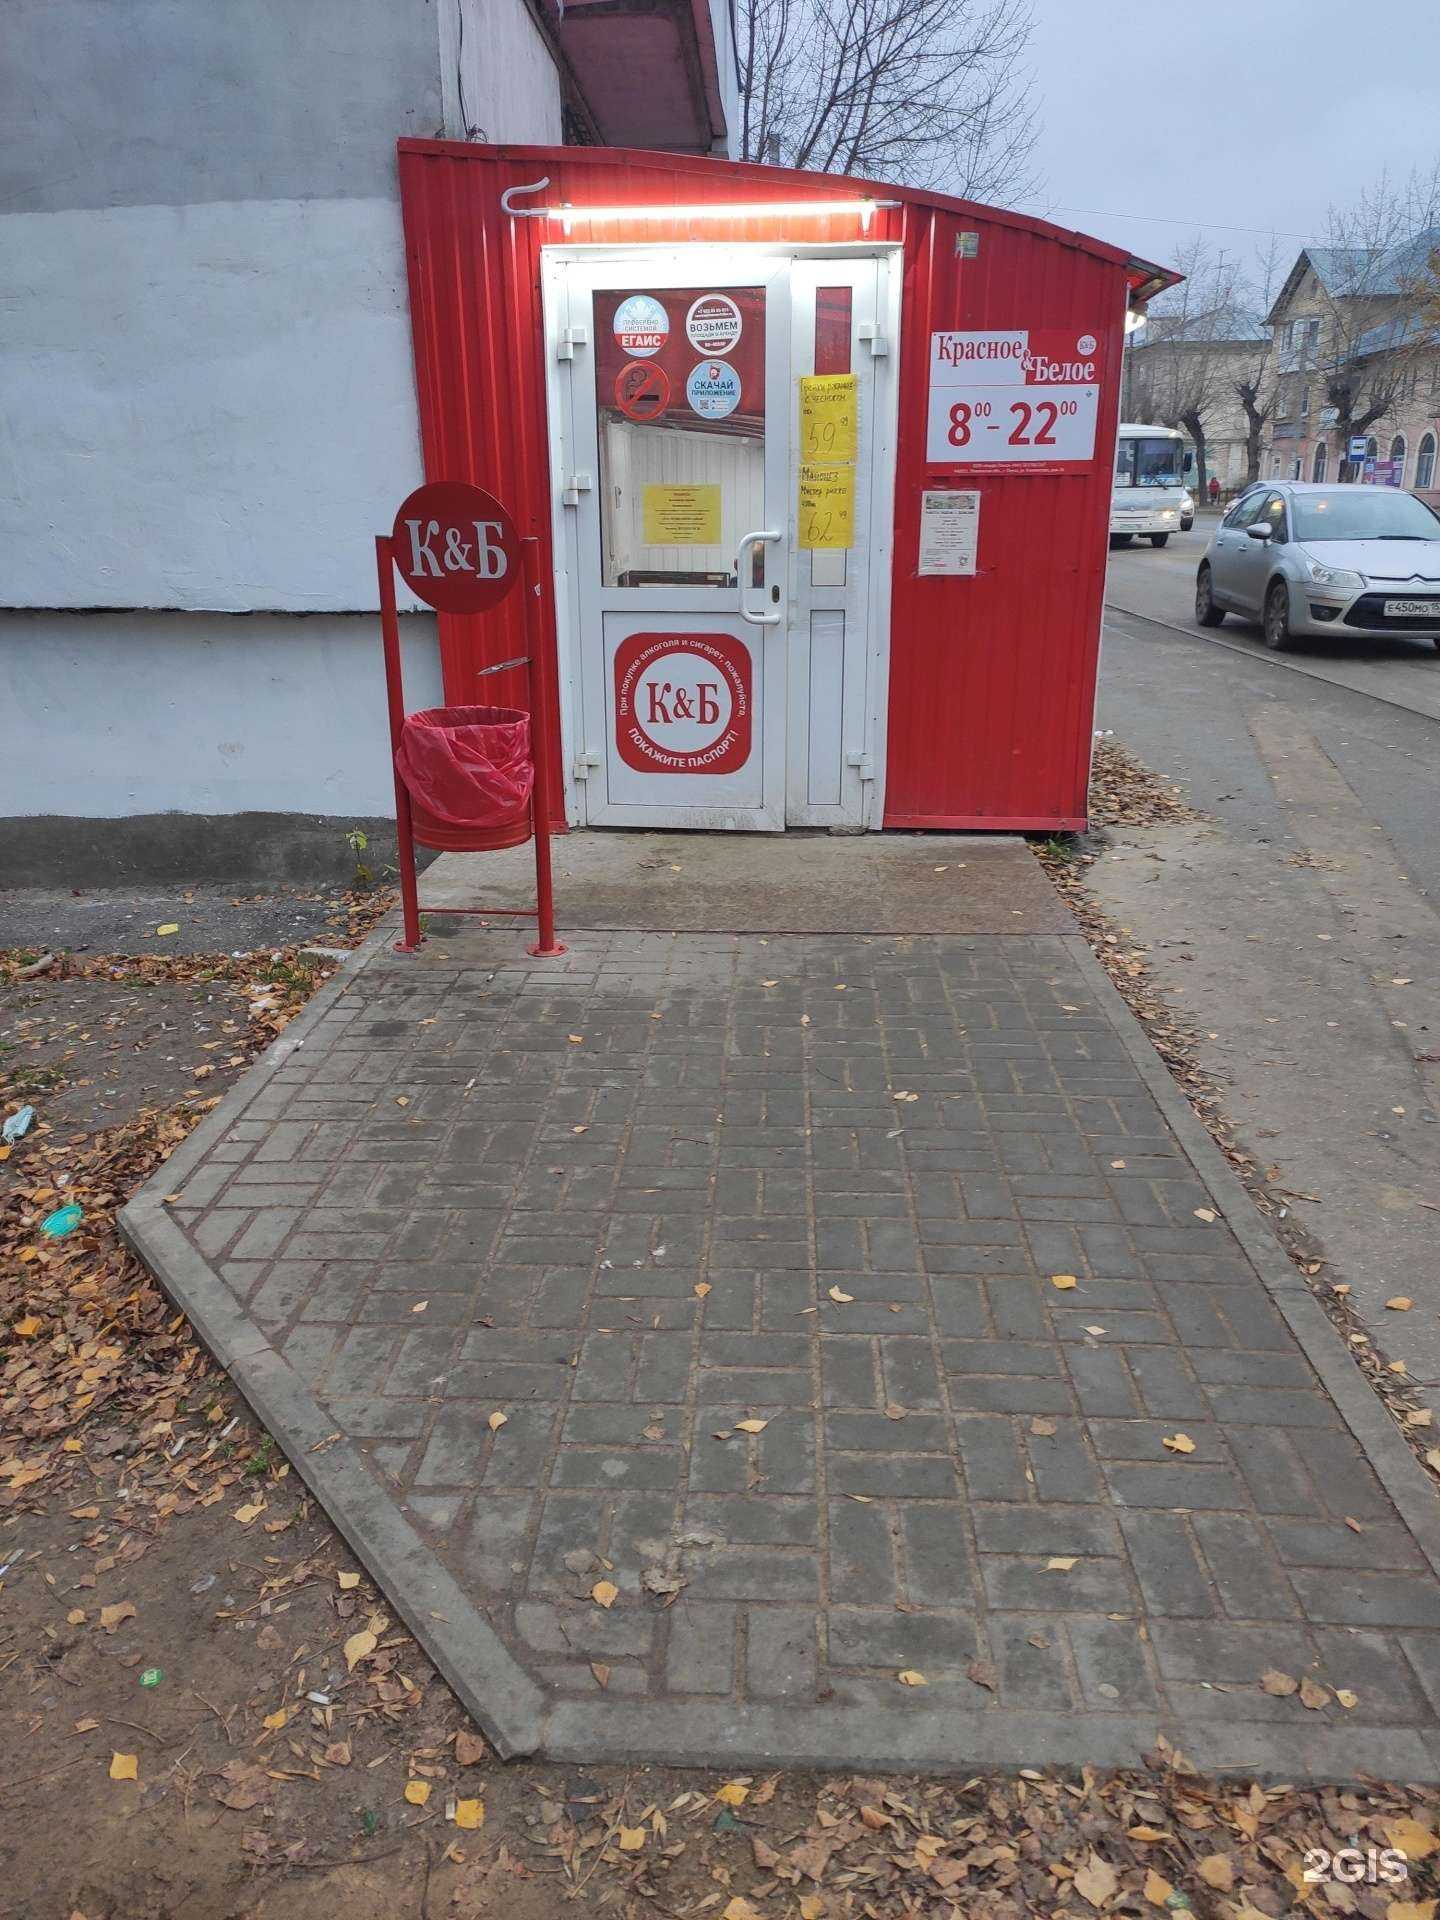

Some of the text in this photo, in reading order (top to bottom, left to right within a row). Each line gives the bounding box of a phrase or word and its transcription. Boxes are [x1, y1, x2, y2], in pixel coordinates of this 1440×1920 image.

[621, 335, 661, 347] ЕГАИС
[690, 321, 738, 333] ВОЗЬМЕМ
[938, 335, 1023, 368] Красное
[1031, 356, 1096, 382] Белое
[694, 379, 734, 390] СКАЧАЙ
[808, 422, 836, 455] 59
[807, 511, 833, 541] 62
[404, 519, 508, 579] К&Б
[640, 638, 680, 661] алкоголя
[690, 640, 725, 663] сигарет,
[621, 658, 642, 695] покупке
[619, 697, 629, 716] При
[646, 682, 720, 725] К&Б
[628, 727, 740, 768] ПОКАЖИТЕ ПАСПОРТ!
